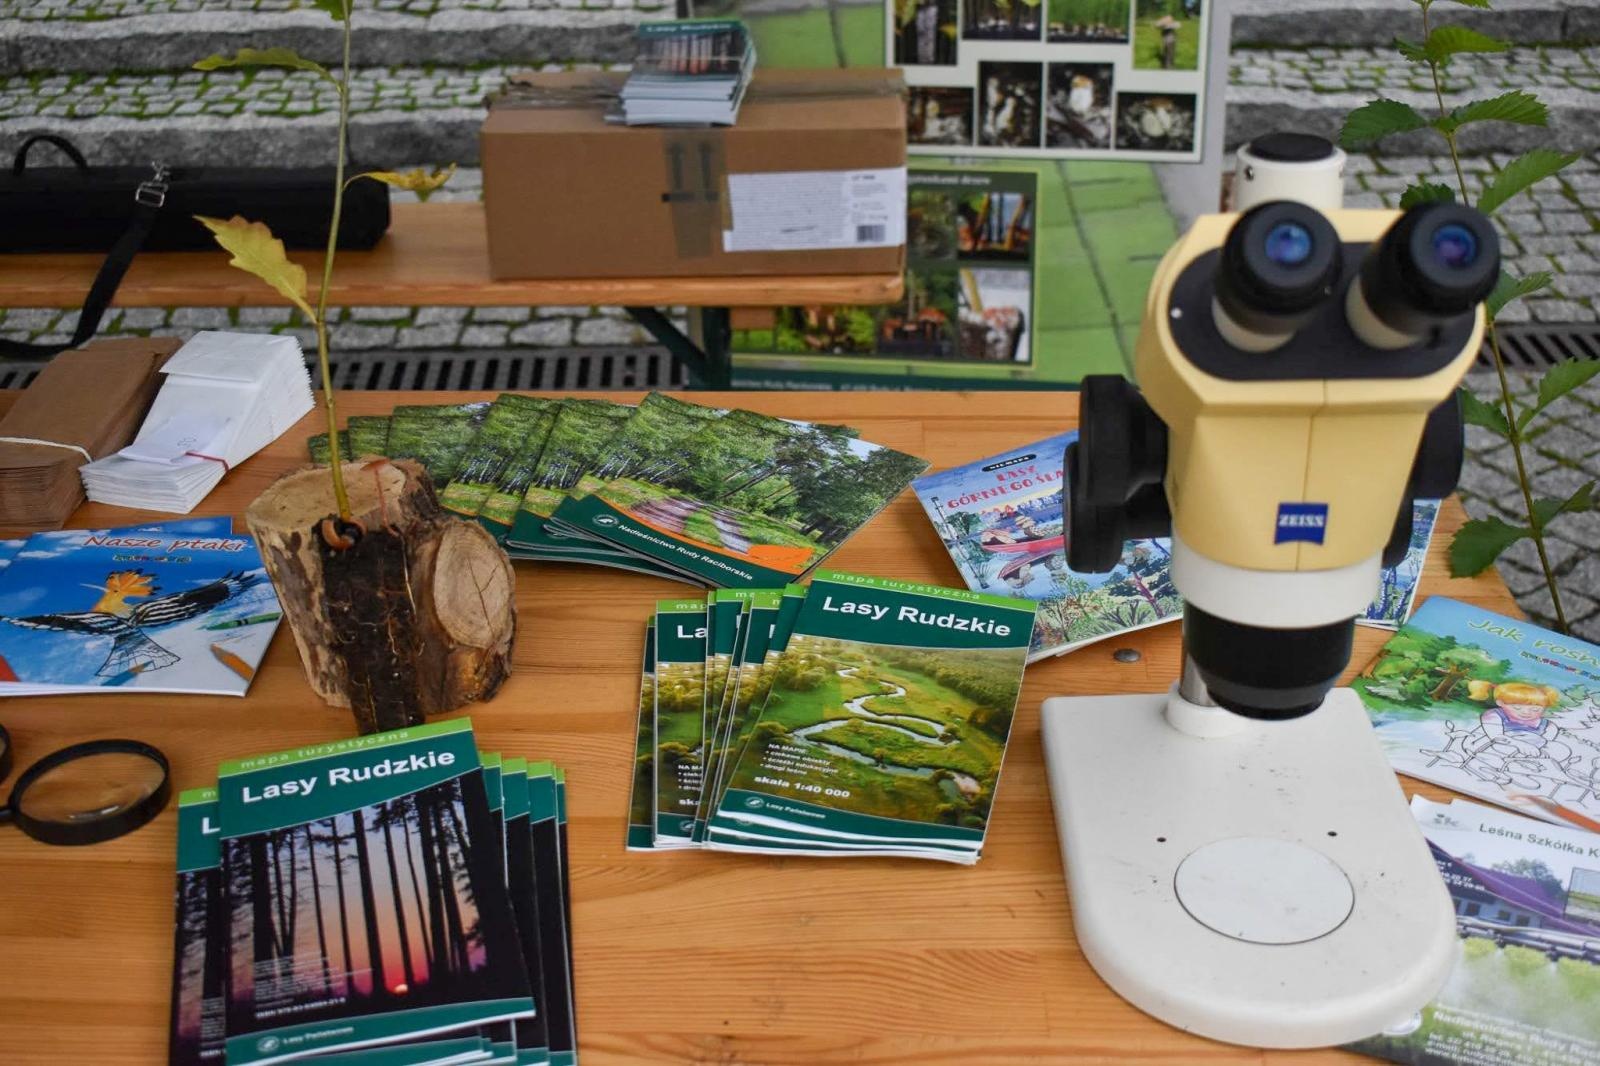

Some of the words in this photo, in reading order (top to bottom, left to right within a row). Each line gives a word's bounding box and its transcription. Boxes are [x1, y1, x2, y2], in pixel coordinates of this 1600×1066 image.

[1279, 514, 1324, 528] ZEISS
[83, 536, 162, 547] Nasze
[167, 539, 248, 554] ptaki
[618, 524, 676, 550] Nadleśnictwo
[676, 547, 701, 560] Rudy
[701, 554, 753, 581] Raciborskie
[832, 571, 876, 585] mapa
[882, 578, 981, 600] turystyczna
[676, 603, 708, 611] map
[822, 596, 890, 621] Lasy
[897, 605, 1012, 638] Rudzkie
[677, 625, 708, 639] La
[1468, 620, 1524, 642] Jak
[1533, 640, 1600, 667] rośn
[241, 753, 289, 770] mapa
[298, 731, 409, 759] turystyczna
[242, 776, 318, 804] Lasy
[329, 750, 456, 787] Rudzkie
[754, 776, 790, 788] skala
[794, 782, 822, 794] 1:40
[825, 788, 850, 798] 000
[1480, 823, 1523, 841] Leśna
[1527, 834, 1585, 857] Szkółka
